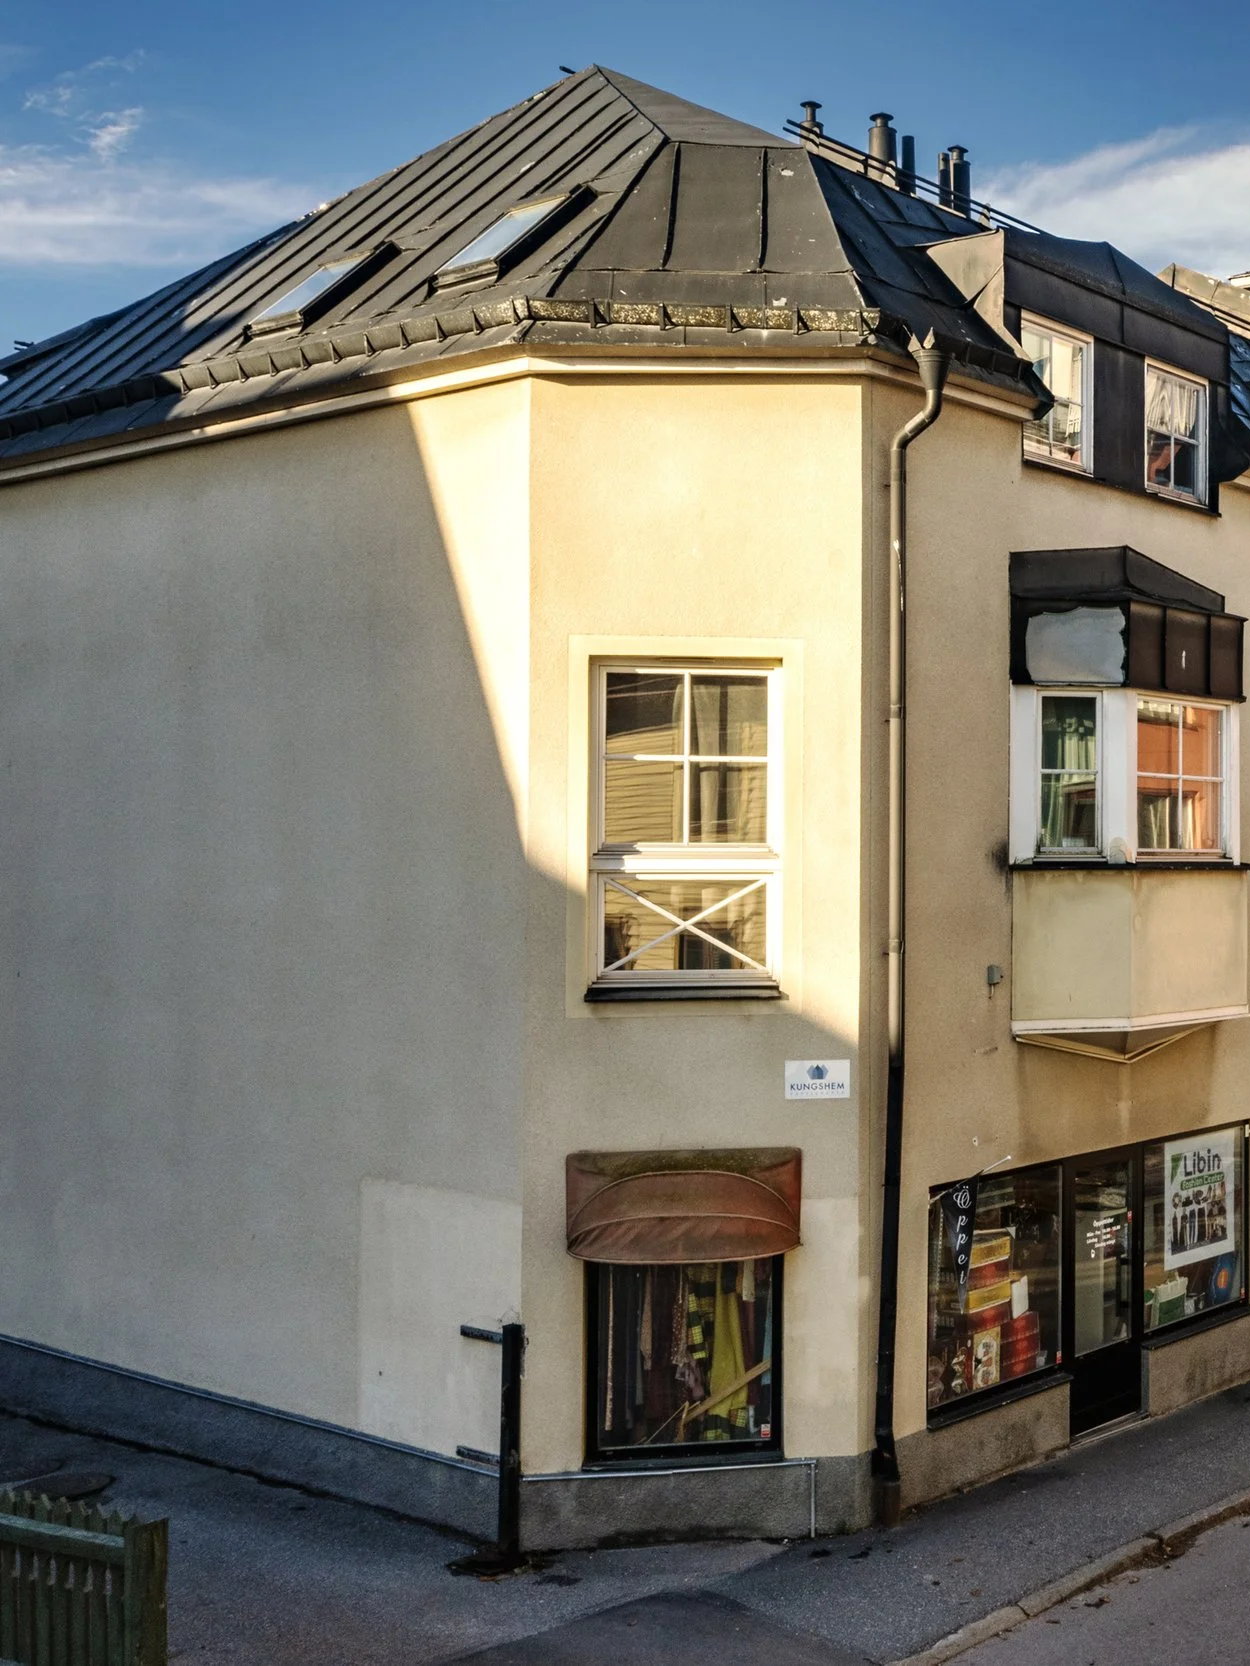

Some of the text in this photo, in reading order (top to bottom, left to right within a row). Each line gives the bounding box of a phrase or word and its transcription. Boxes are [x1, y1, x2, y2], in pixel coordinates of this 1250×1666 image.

[790, 1082, 845, 1091] KUNGSHEM
[1184, 1148, 1221, 1177] Libin
[953, 1185, 972, 1285] Öppet
